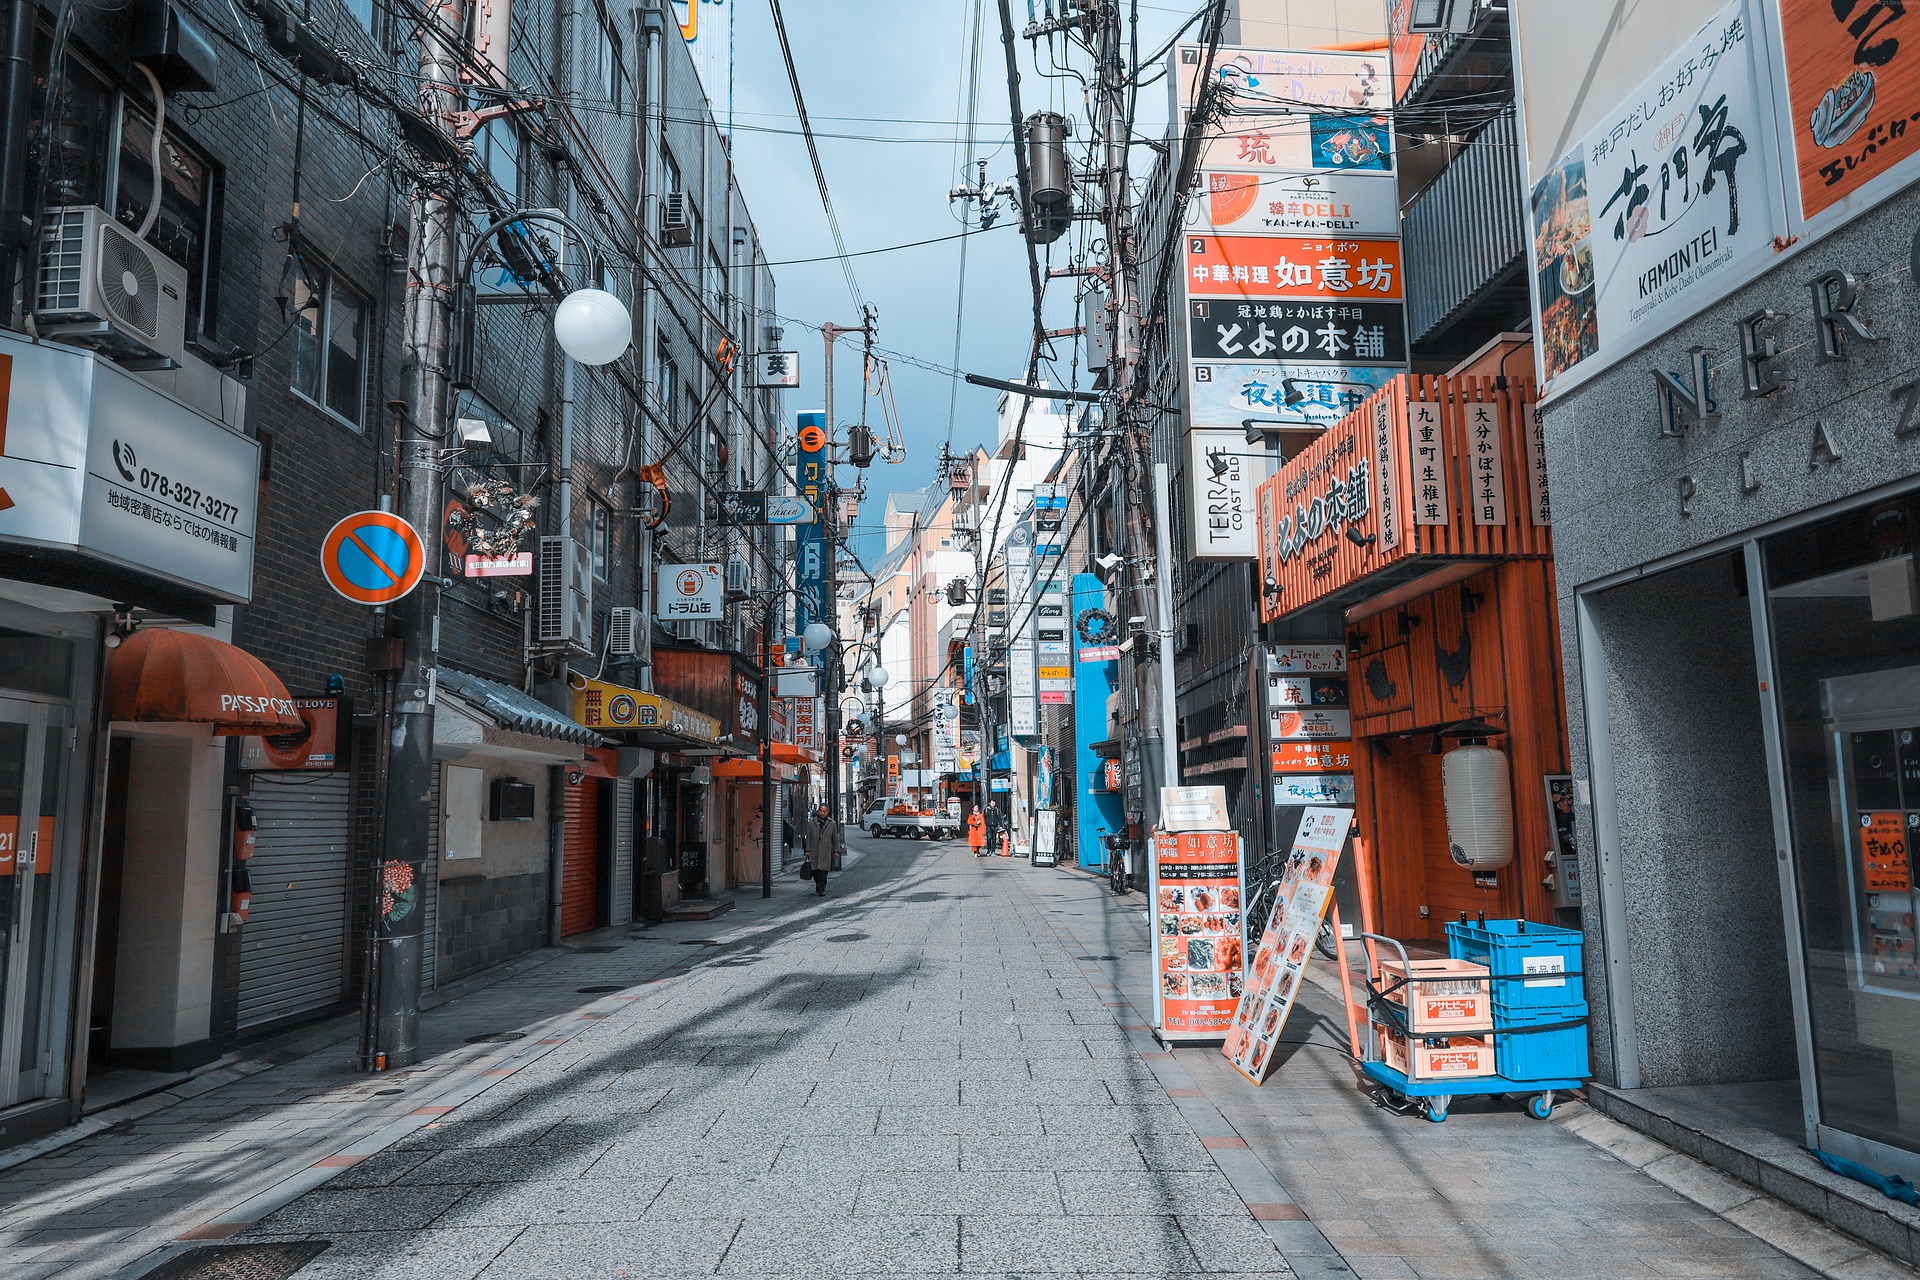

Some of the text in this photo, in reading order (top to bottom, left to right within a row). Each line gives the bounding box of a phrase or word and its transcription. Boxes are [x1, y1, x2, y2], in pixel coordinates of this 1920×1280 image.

[1185, 52, 1193, 62] 7
[1257, 55, 1324, 79] Little
[1292, 80, 1349, 103] Devil
[1237, 130, 1276, 164] 琉
[1269, 201, 1351, 217] 韓辛DELI
[1193, 241, 1203, 252] 2
[1301, 242, 1359, 253] ニョイボウ
[1639, 226, 1717, 299] KAMONTEI
[1192, 255, 1394, 292] 中華料理 如意坊
[1663, 282, 1678, 300] Kobe
[1679, 271, 1695, 290] Dashi
[1695, 246, 1734, 280] Okonomiyaki
[1196, 304, 1205, 316] 1
[1237, 304, 1363, 320] 冠地鶏とかぼす平目
[1217, 322, 1385, 358] とよの本舗
[767, 355, 790, 376] 英
[1197, 369, 1209, 381] B
[1252, 368, 1349, 379] ツーショットキャバクラ
[1417, 407, 1440, 521] 九重町生椎茸
[1474, 407, 1496, 521] 大分かぼす平目
[140, 467, 238, 525] 078-327-3277
[1231, 456, 1243, 531] COAST BLD
[1278, 456, 1370, 563] とよの本舗
[107, 489, 238, 552] 地域密着店ならではの情報量
[668, 602, 711, 614] ドラム缶
[1040, 606, 1060, 616] Glory
[1290, 649, 1320, 659] Little
[1305, 659, 1332, 670] Devil
[1284, 685, 1304, 703] 琉
[306, 700, 333, 708] LOVE
[585, 690, 602, 725] 無料
[1295, 745, 1330, 753] 中華料理
[1304, 754, 1350, 767] 如意坊
[1275, 777, 1282, 785] B
[1160, 834, 1233, 848] 中華 如意坊
[1187, 849, 1234, 858] ニョイボウ
[1428, 1000, 1474, 1010] アサヒビール
[1168, 1017, 1186, 1026] TEL:
[1431, 1053, 1477, 1063] アサヒビール
